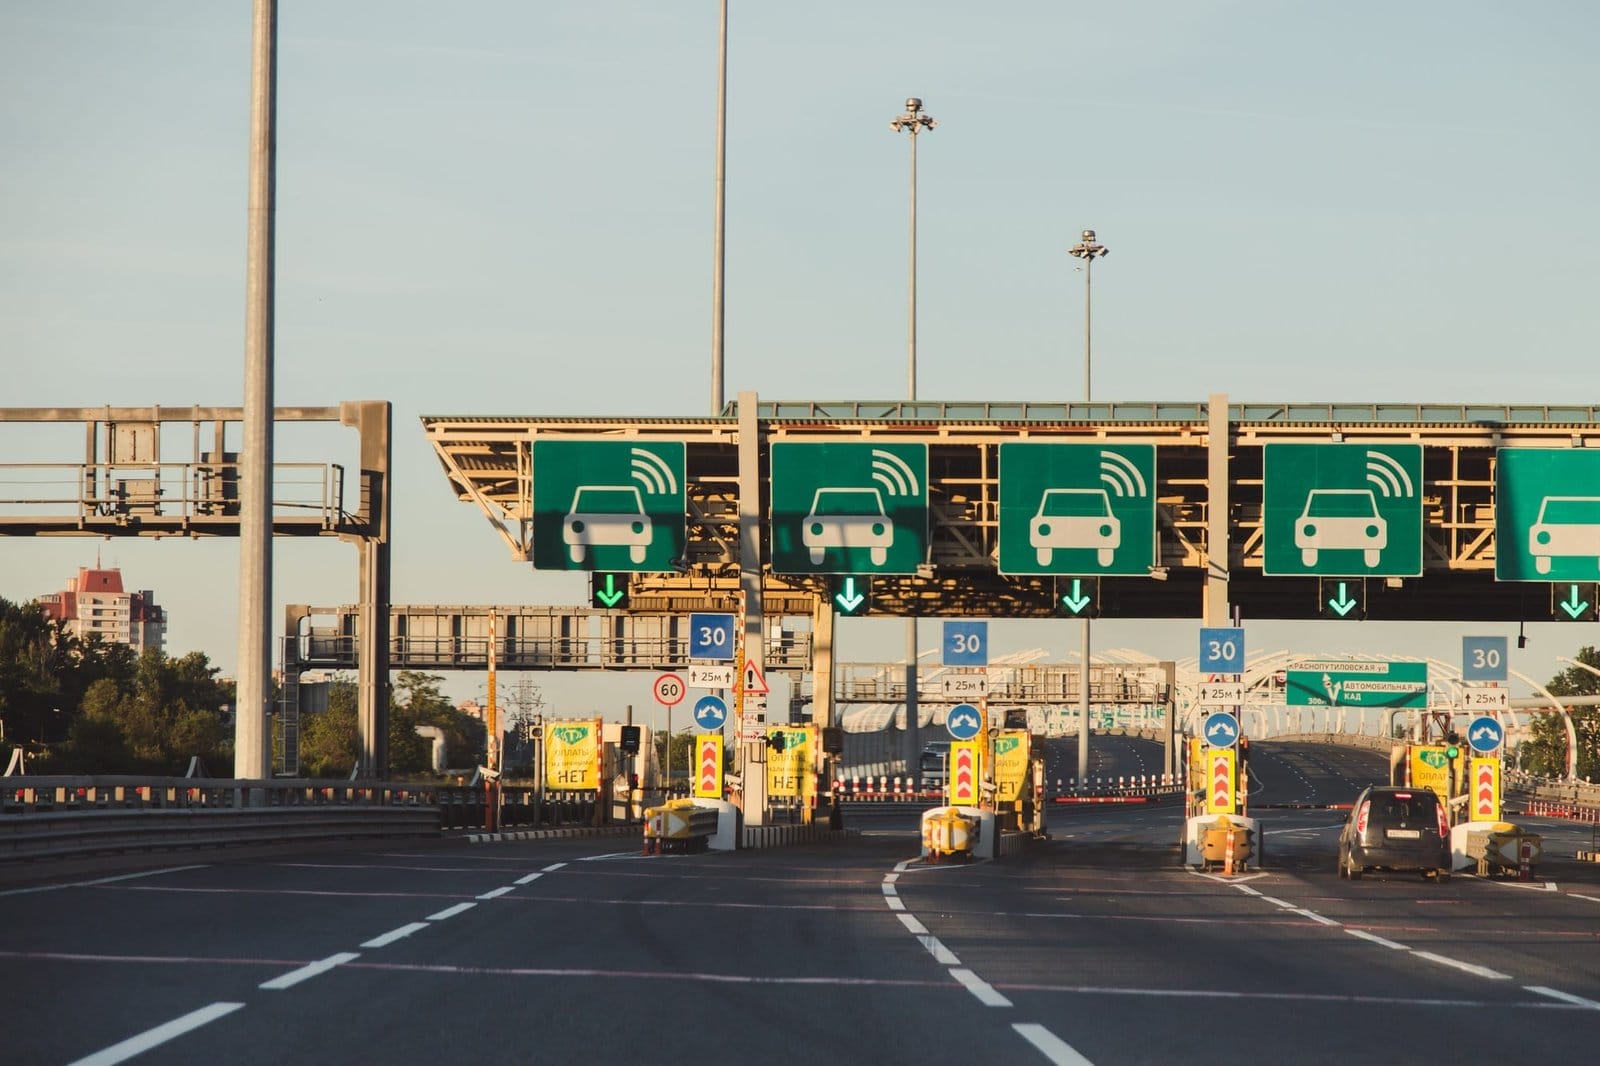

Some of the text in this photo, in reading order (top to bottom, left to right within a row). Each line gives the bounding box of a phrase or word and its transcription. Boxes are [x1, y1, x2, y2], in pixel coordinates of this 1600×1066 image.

[699, 626, 726, 646] 30
[952, 633, 980, 653] 30
[1208, 640, 1236, 660] 30
[1472, 648, 1500, 668] 30
[701, 672, 722, 682] 25м
[661, 683, 678, 696] 60
[955, 680, 976, 690] 25м
[1345, 683, 1413, 691] АВТОМОБИЛЬНАЯ
[1211, 689, 1232, 699] 25м
[1344, 692, 1361, 700] КАД
[1475, 693, 1496, 704] 25м
[558, 770, 587, 783] НЕТ
[774, 776, 803, 789] НЕТ
[995, 781, 1018, 795] ЕТ
